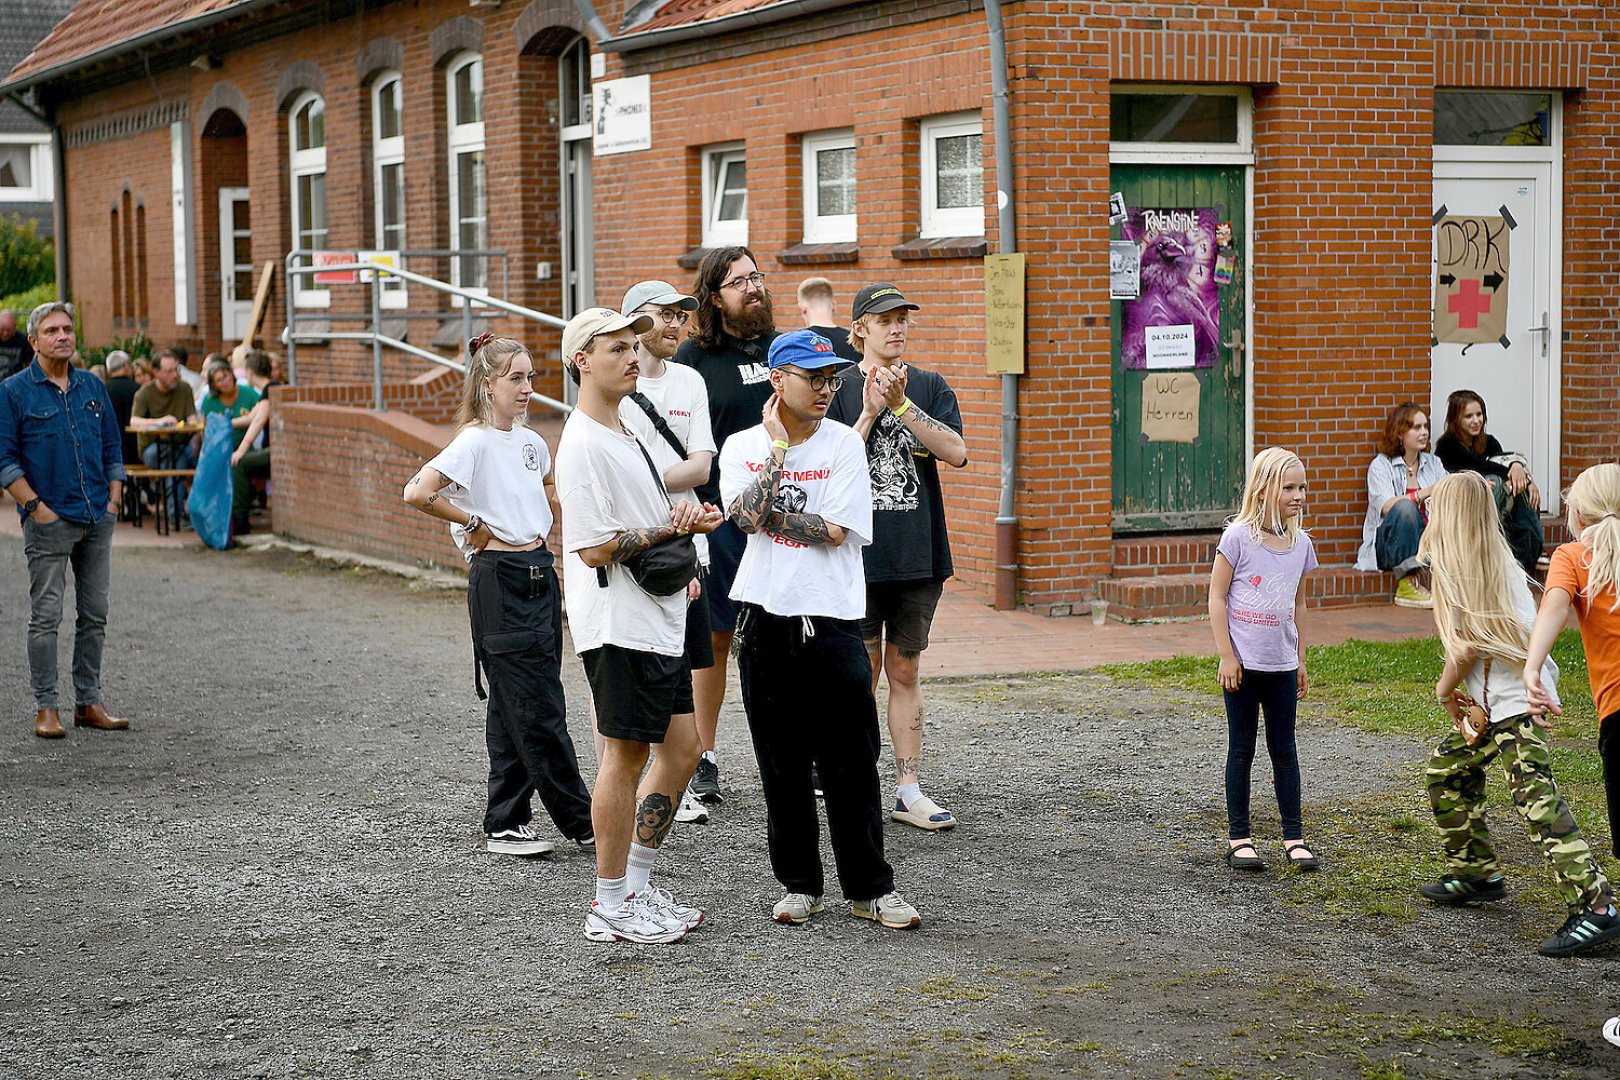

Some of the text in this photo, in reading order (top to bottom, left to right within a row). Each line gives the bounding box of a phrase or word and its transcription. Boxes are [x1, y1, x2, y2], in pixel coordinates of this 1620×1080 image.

[1441, 219, 1506, 273] DRK
[1151, 333, 1188, 342] 04.10.2024
[1156, 377, 1181, 394] WC
[1146, 400, 1193, 421] Herren
[793, 467, 831, 482] MENÜ
[1252, 611, 1263, 619] WE
[1265, 613, 1277, 621] GO
[1253, 618, 1280, 627] UNITED
